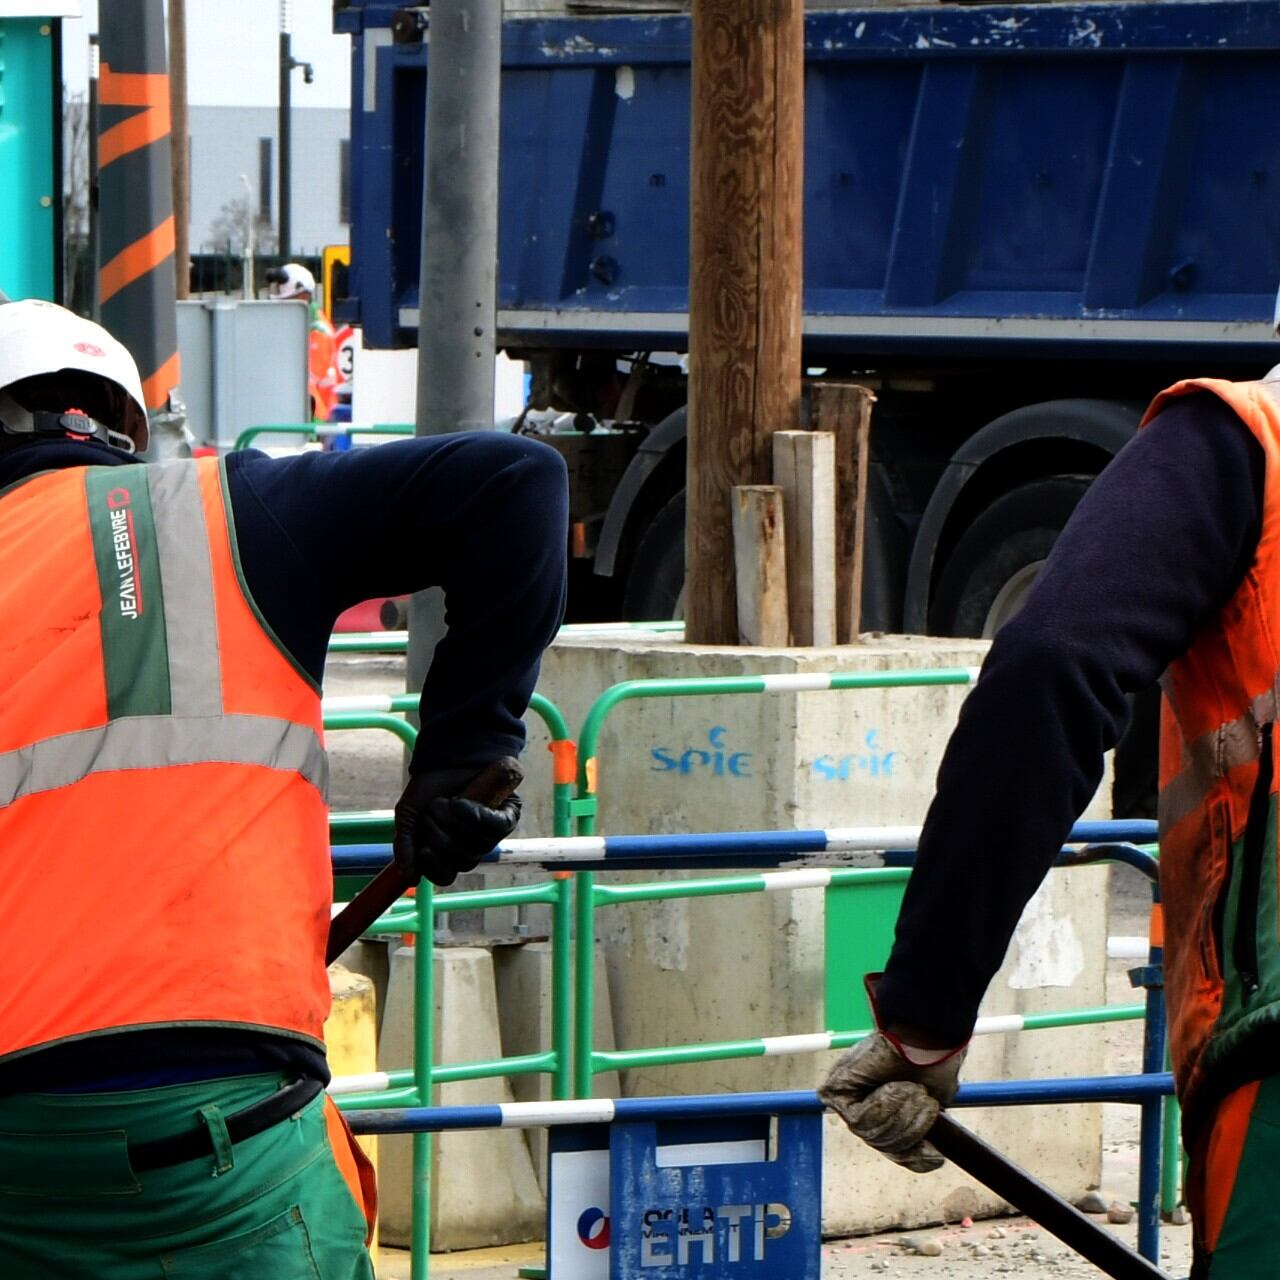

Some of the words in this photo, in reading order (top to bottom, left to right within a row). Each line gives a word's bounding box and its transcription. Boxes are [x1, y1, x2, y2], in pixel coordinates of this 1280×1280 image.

[110, 509, 134, 579] LEFEBVRE
[120, 578, 138, 620] JEAN
[640, 1202, 793, 1268] EHTP
